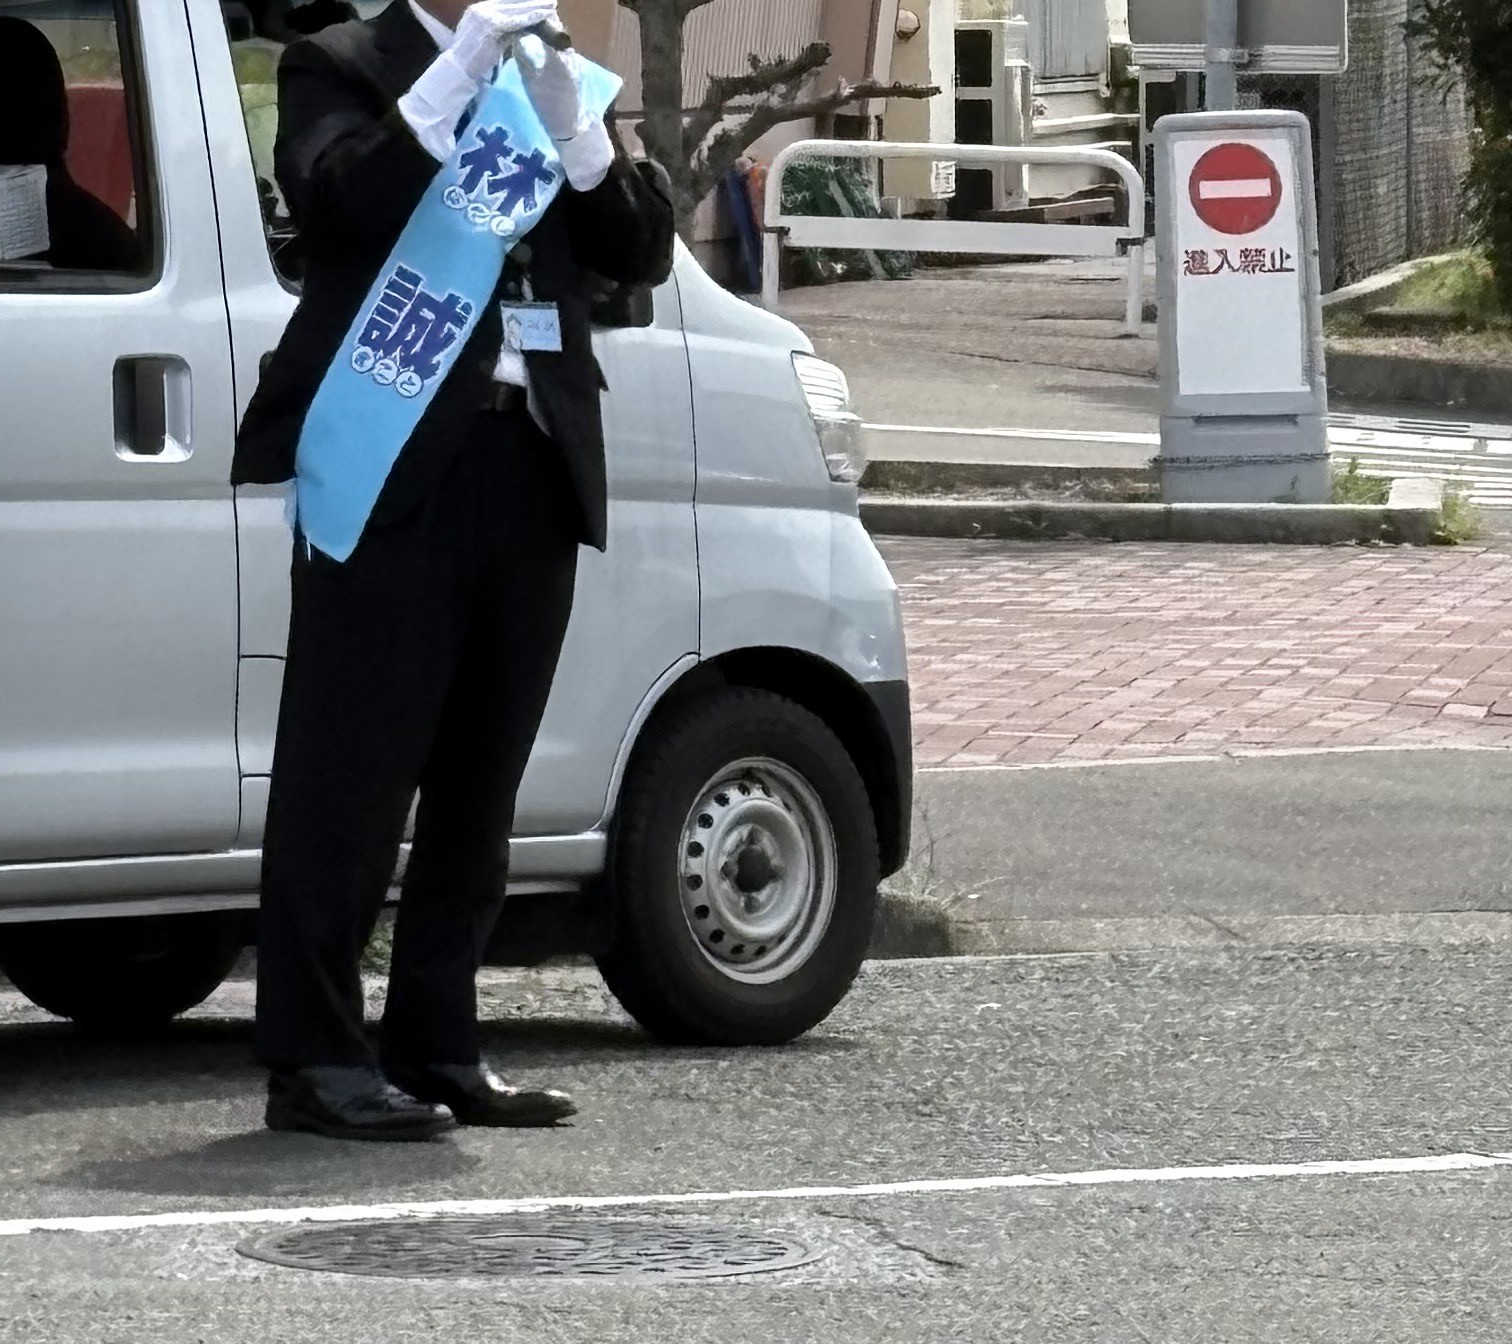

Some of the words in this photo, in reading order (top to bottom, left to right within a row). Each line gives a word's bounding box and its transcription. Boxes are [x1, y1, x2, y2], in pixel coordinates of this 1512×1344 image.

[459, 124, 554, 215] 林
[1183, 246, 1296, 276] 進入禁止
[356, 264, 473, 381] 誠
